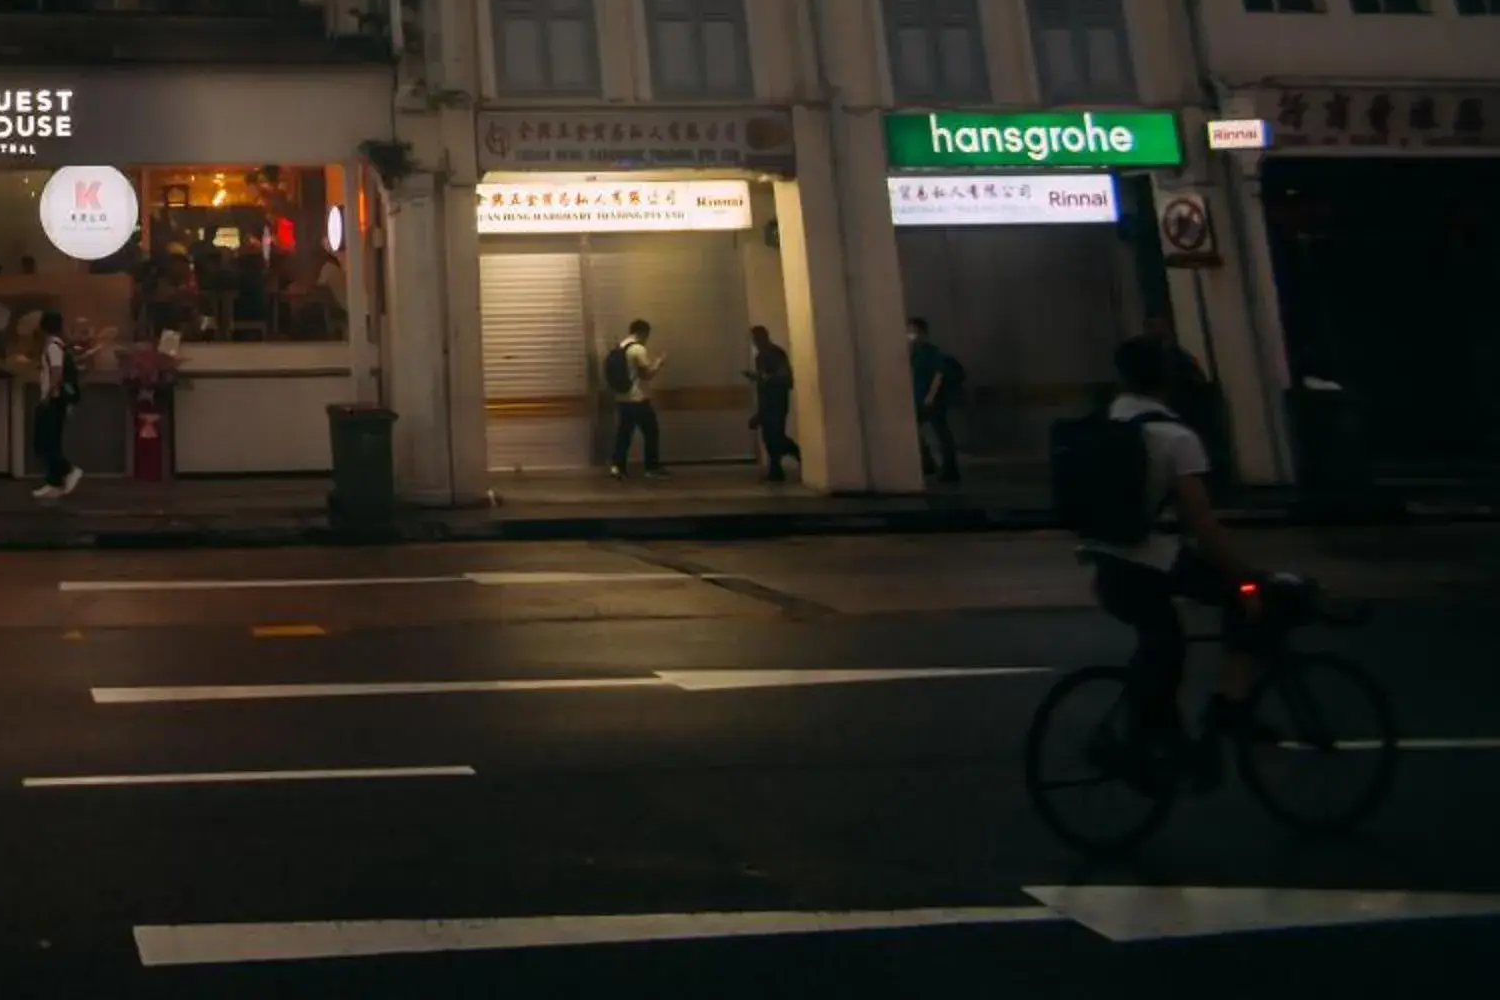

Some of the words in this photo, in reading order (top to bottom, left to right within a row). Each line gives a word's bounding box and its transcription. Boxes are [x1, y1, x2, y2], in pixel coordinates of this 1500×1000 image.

[930, 112, 1133, 161] hansgrohe
[1213, 127, 1257, 141] Rinnai
[74, 180, 102, 210] K
[1049, 190, 1107, 208] Rinnai
